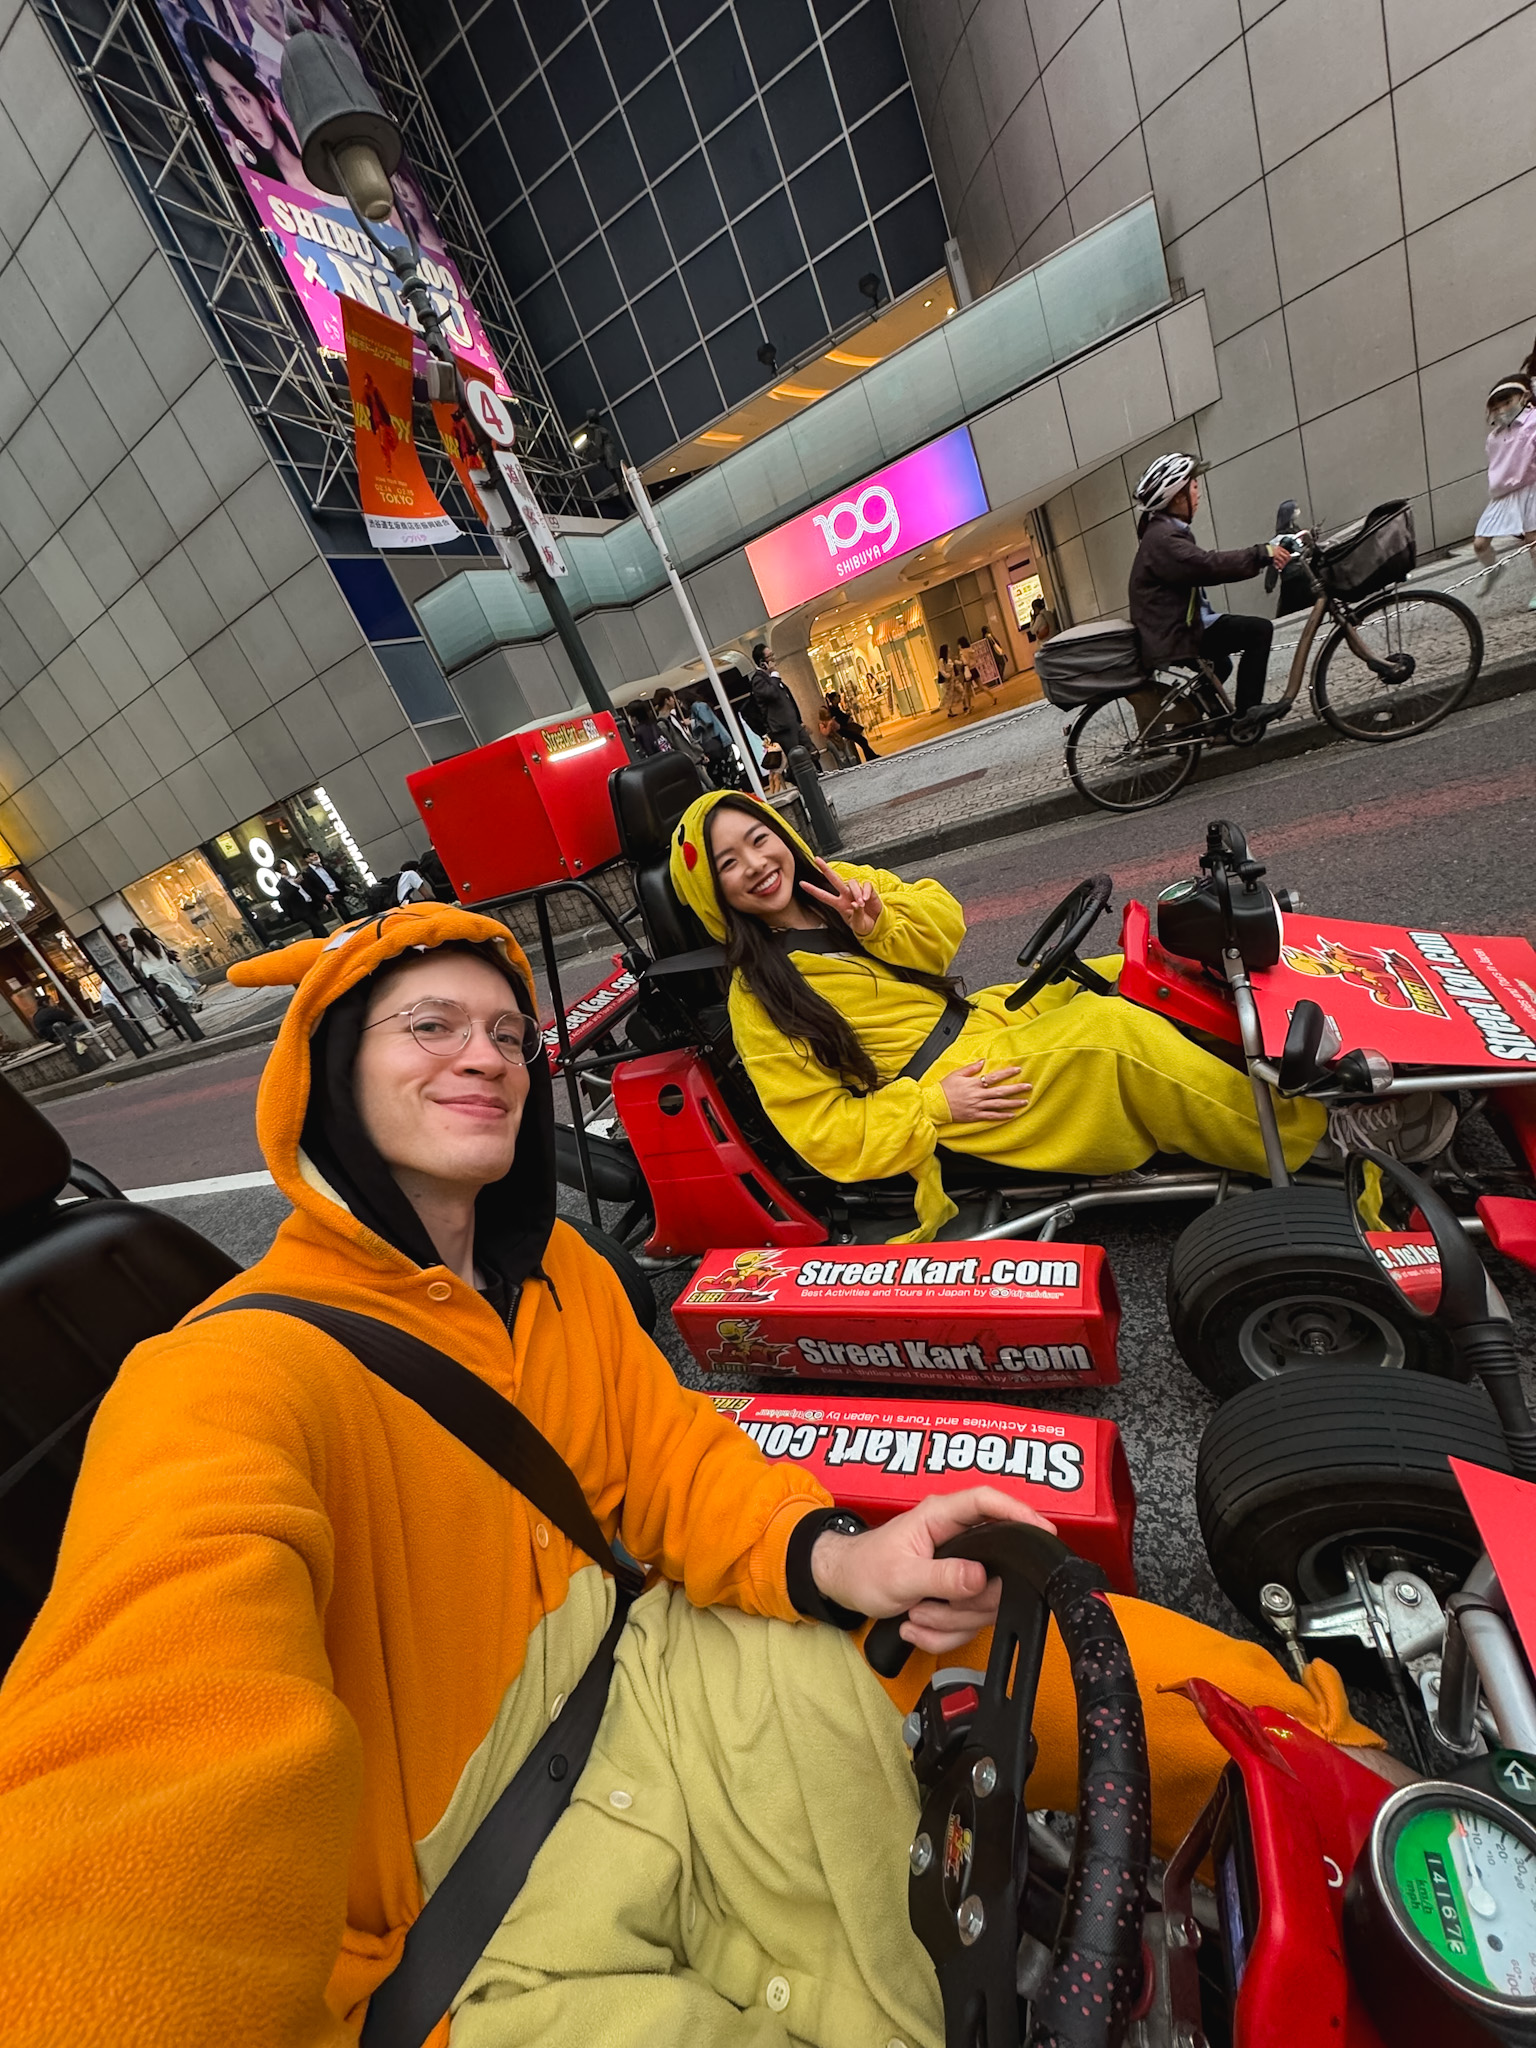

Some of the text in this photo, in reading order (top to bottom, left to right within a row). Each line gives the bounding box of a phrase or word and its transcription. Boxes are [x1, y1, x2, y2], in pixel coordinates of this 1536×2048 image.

[268, 195, 398, 272] SHIBU
[479, 391, 505, 435] 4
[380, 492, 414, 506] TOKYO
[812, 486, 900, 556] 109
[836, 545, 881, 576] SHIBUYA
[1428, 965, 1498, 1003] Kart
[577, 989, 620, 1012] Kart
[1453, 999, 1536, 1062] Street
[797, 1257, 1079, 1287] Street Kart .com
[801, 1289, 822, 1297] Best
[823, 1288, 870, 1297] Activities
[872, 1288, 891, 1297] and
[893, 1288, 923, 1297] Tours
[926, 1288, 936, 1297] in
[938, 1288, 971, 1298] Japan
[974, 1287, 987, 1298] by
[797, 1338, 1094, 1372] Street Kart .com
[844, 1367, 891, 1377] Ativities
[913, 1371, 943, 1380] Tours
[958, 1373, 989, 1382] Japn
[994, 1373, 1007, 1383] by
[826, 1410, 840, 1420] by
[843, 1411, 880, 1424] Japan
[882, 1412, 894, 1423] in
[896, 1415, 931, 1426] Tours
[935, 1416, 959, 1426] and
[963, 1418, 1027, 1433] Activities
[1031, 1424, 1065, 1437] Best
[827, 1426, 925, 1474] Kart
[926, 1431, 1083, 1491] Street
[1472, 1832, 1482, 1845] 10
[1496, 1843, 1508, 1863] 20
[1515, 1857, 1528, 1874] 30
[1407, 1879, 1420, 1910] mph
[1418, 1869, 1433, 1914] km/h
